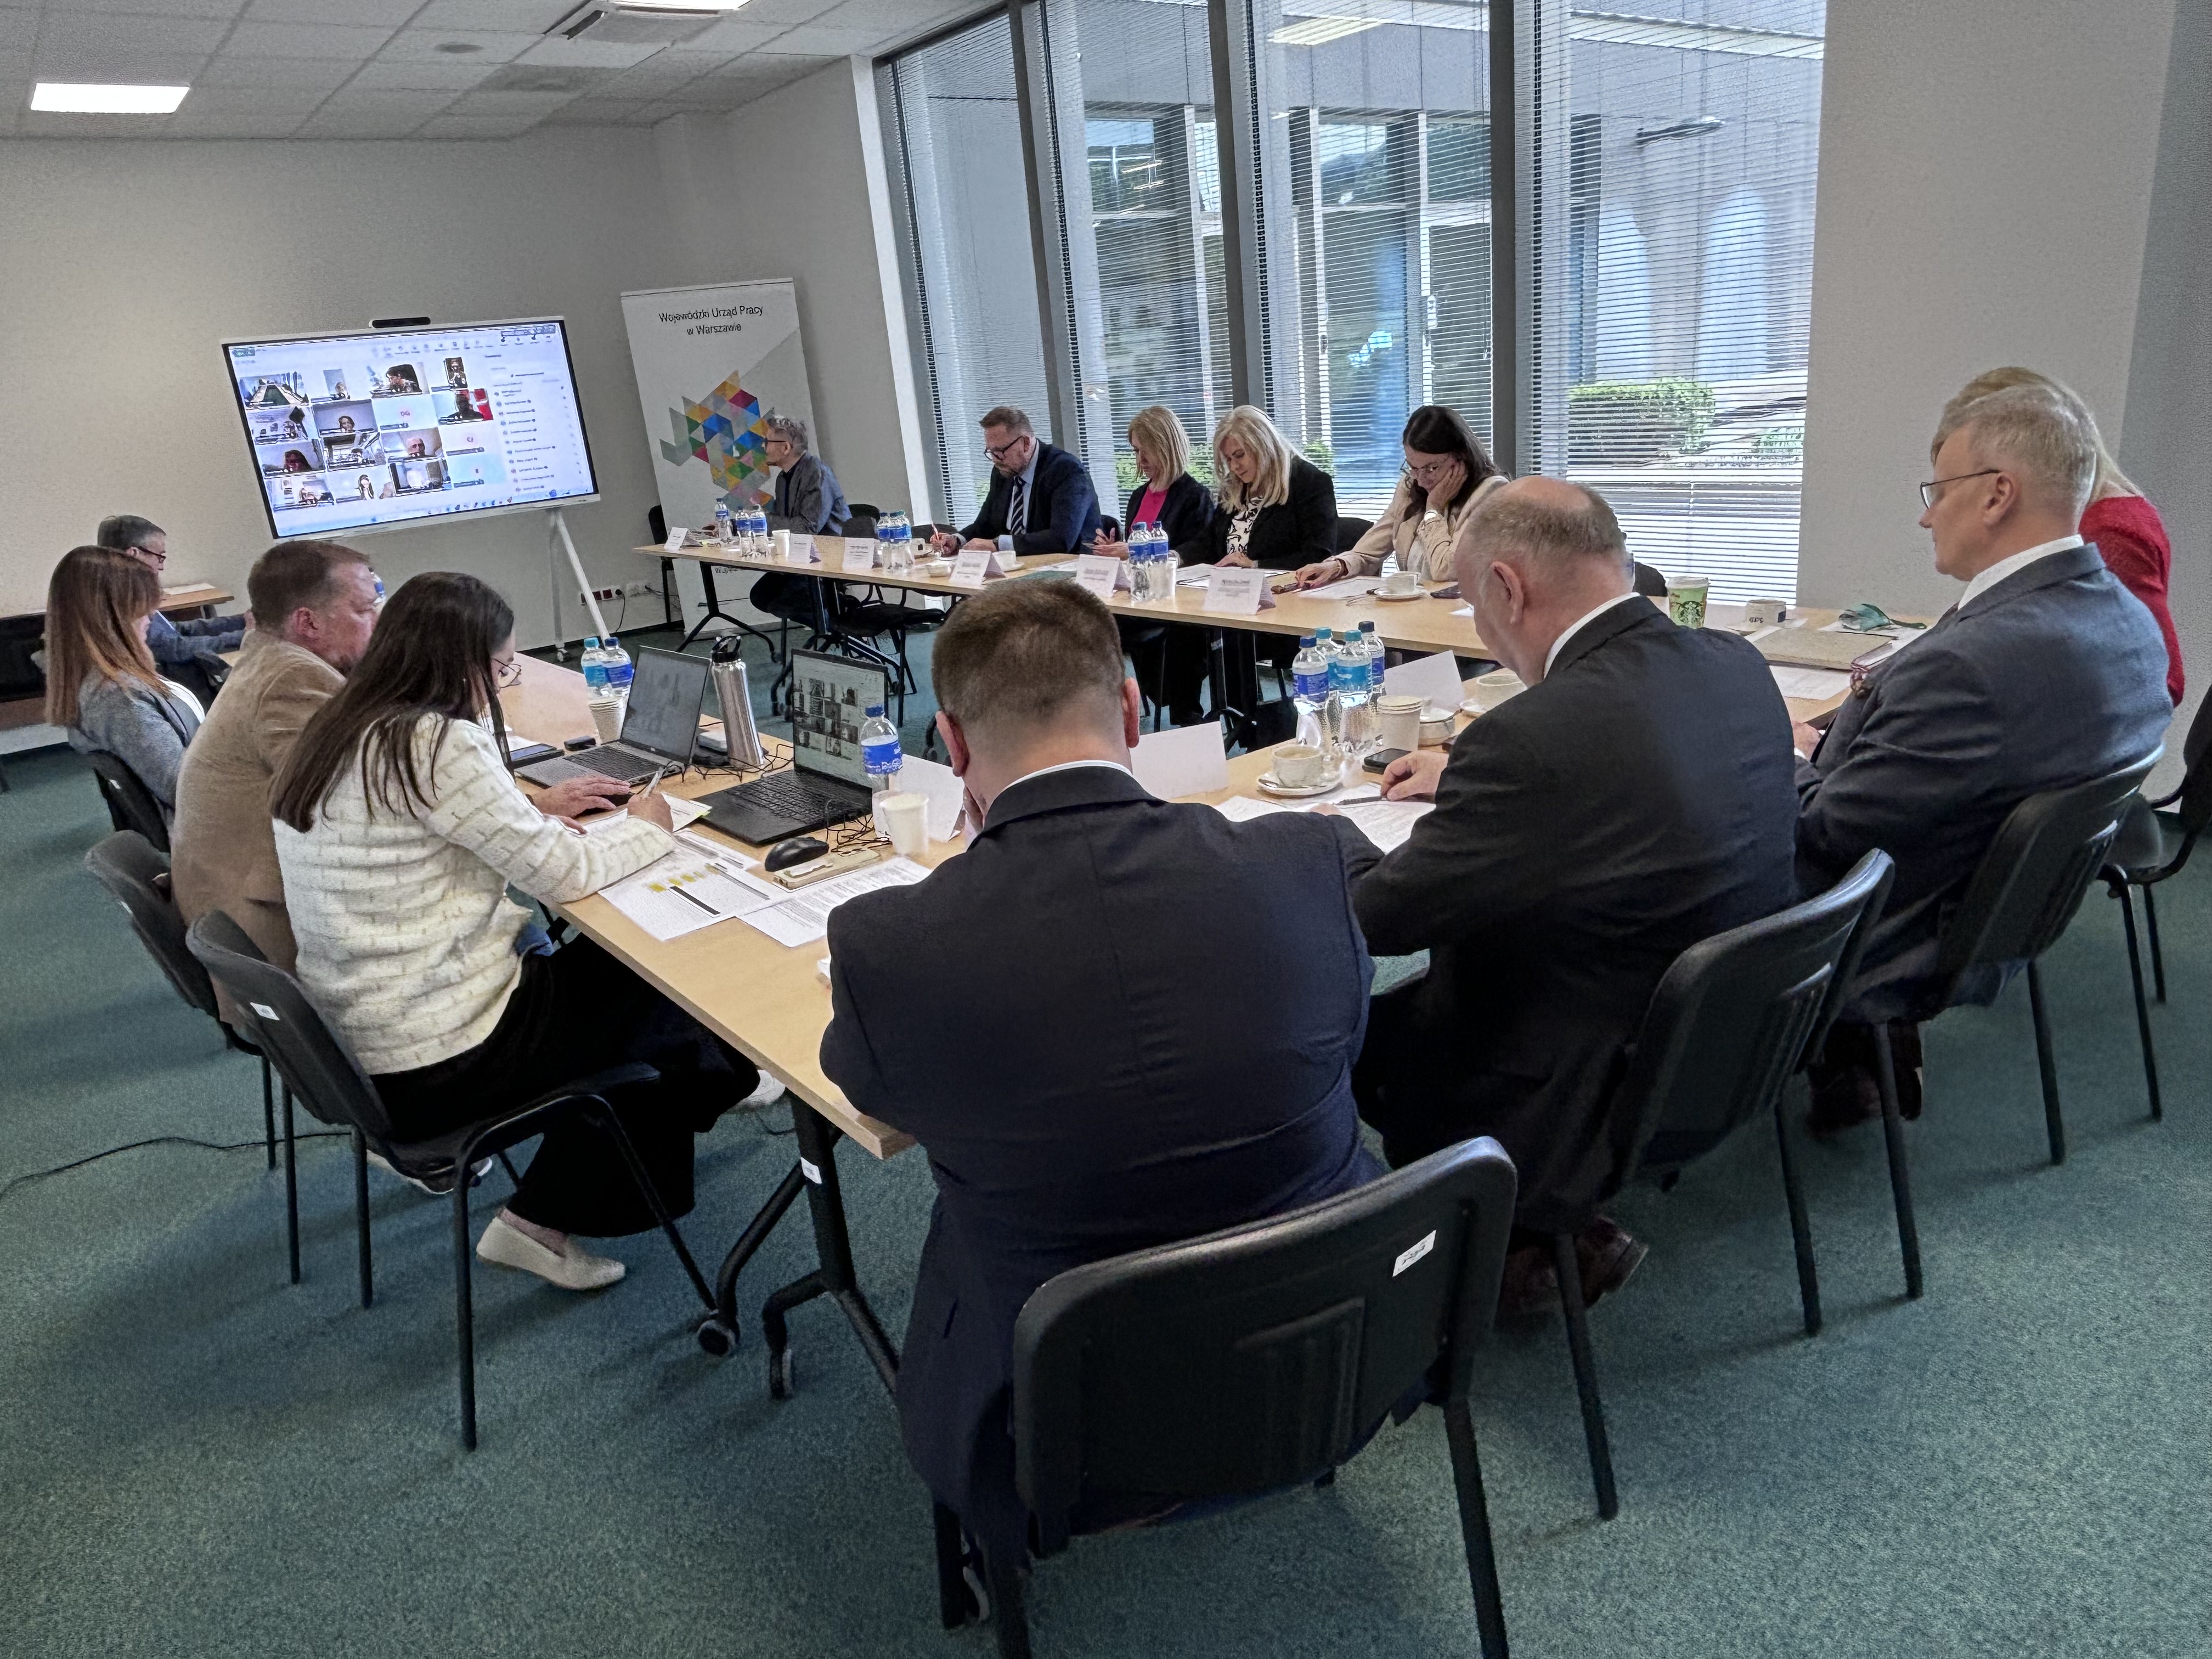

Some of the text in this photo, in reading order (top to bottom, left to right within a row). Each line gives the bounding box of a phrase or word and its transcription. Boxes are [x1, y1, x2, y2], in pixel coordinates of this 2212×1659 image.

[712, 307, 737, 318] Urząd
[739, 306, 763, 317] Pracy
[696, 323, 742, 335] Warszawie
